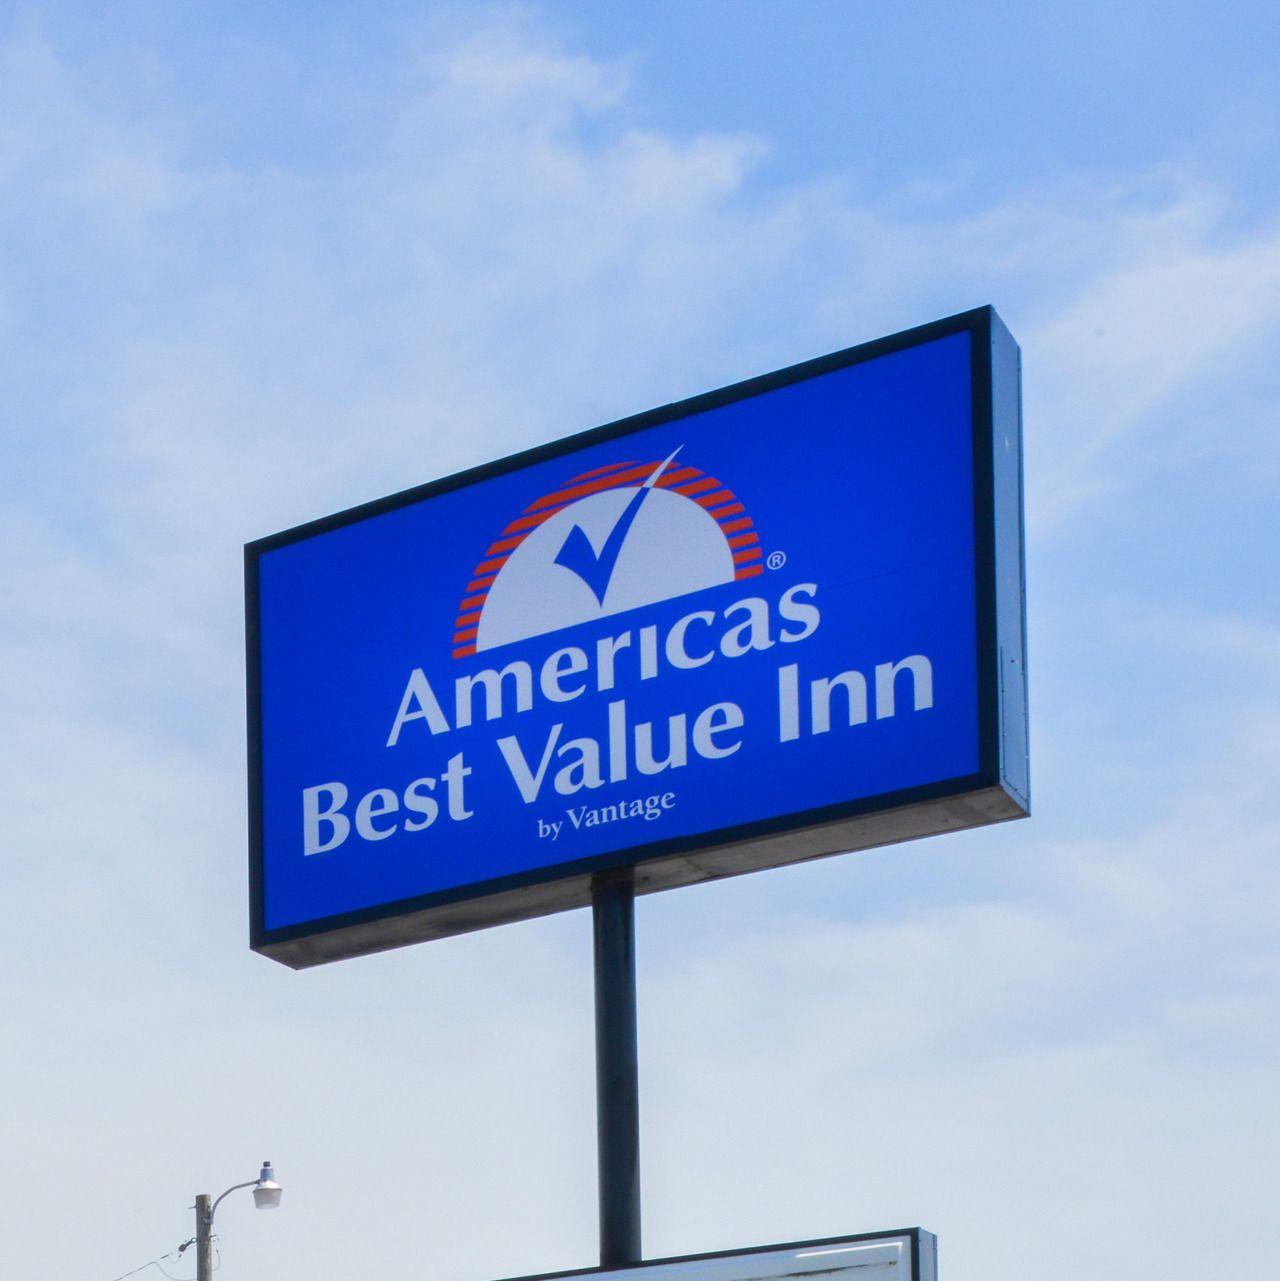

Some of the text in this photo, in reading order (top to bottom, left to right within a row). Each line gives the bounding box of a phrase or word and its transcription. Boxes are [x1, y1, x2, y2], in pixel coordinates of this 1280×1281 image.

[386, 582, 822, 748] Americas
[301, 652, 934, 857] Best Value Inn
[538, 791, 677, 841] by Vantage
